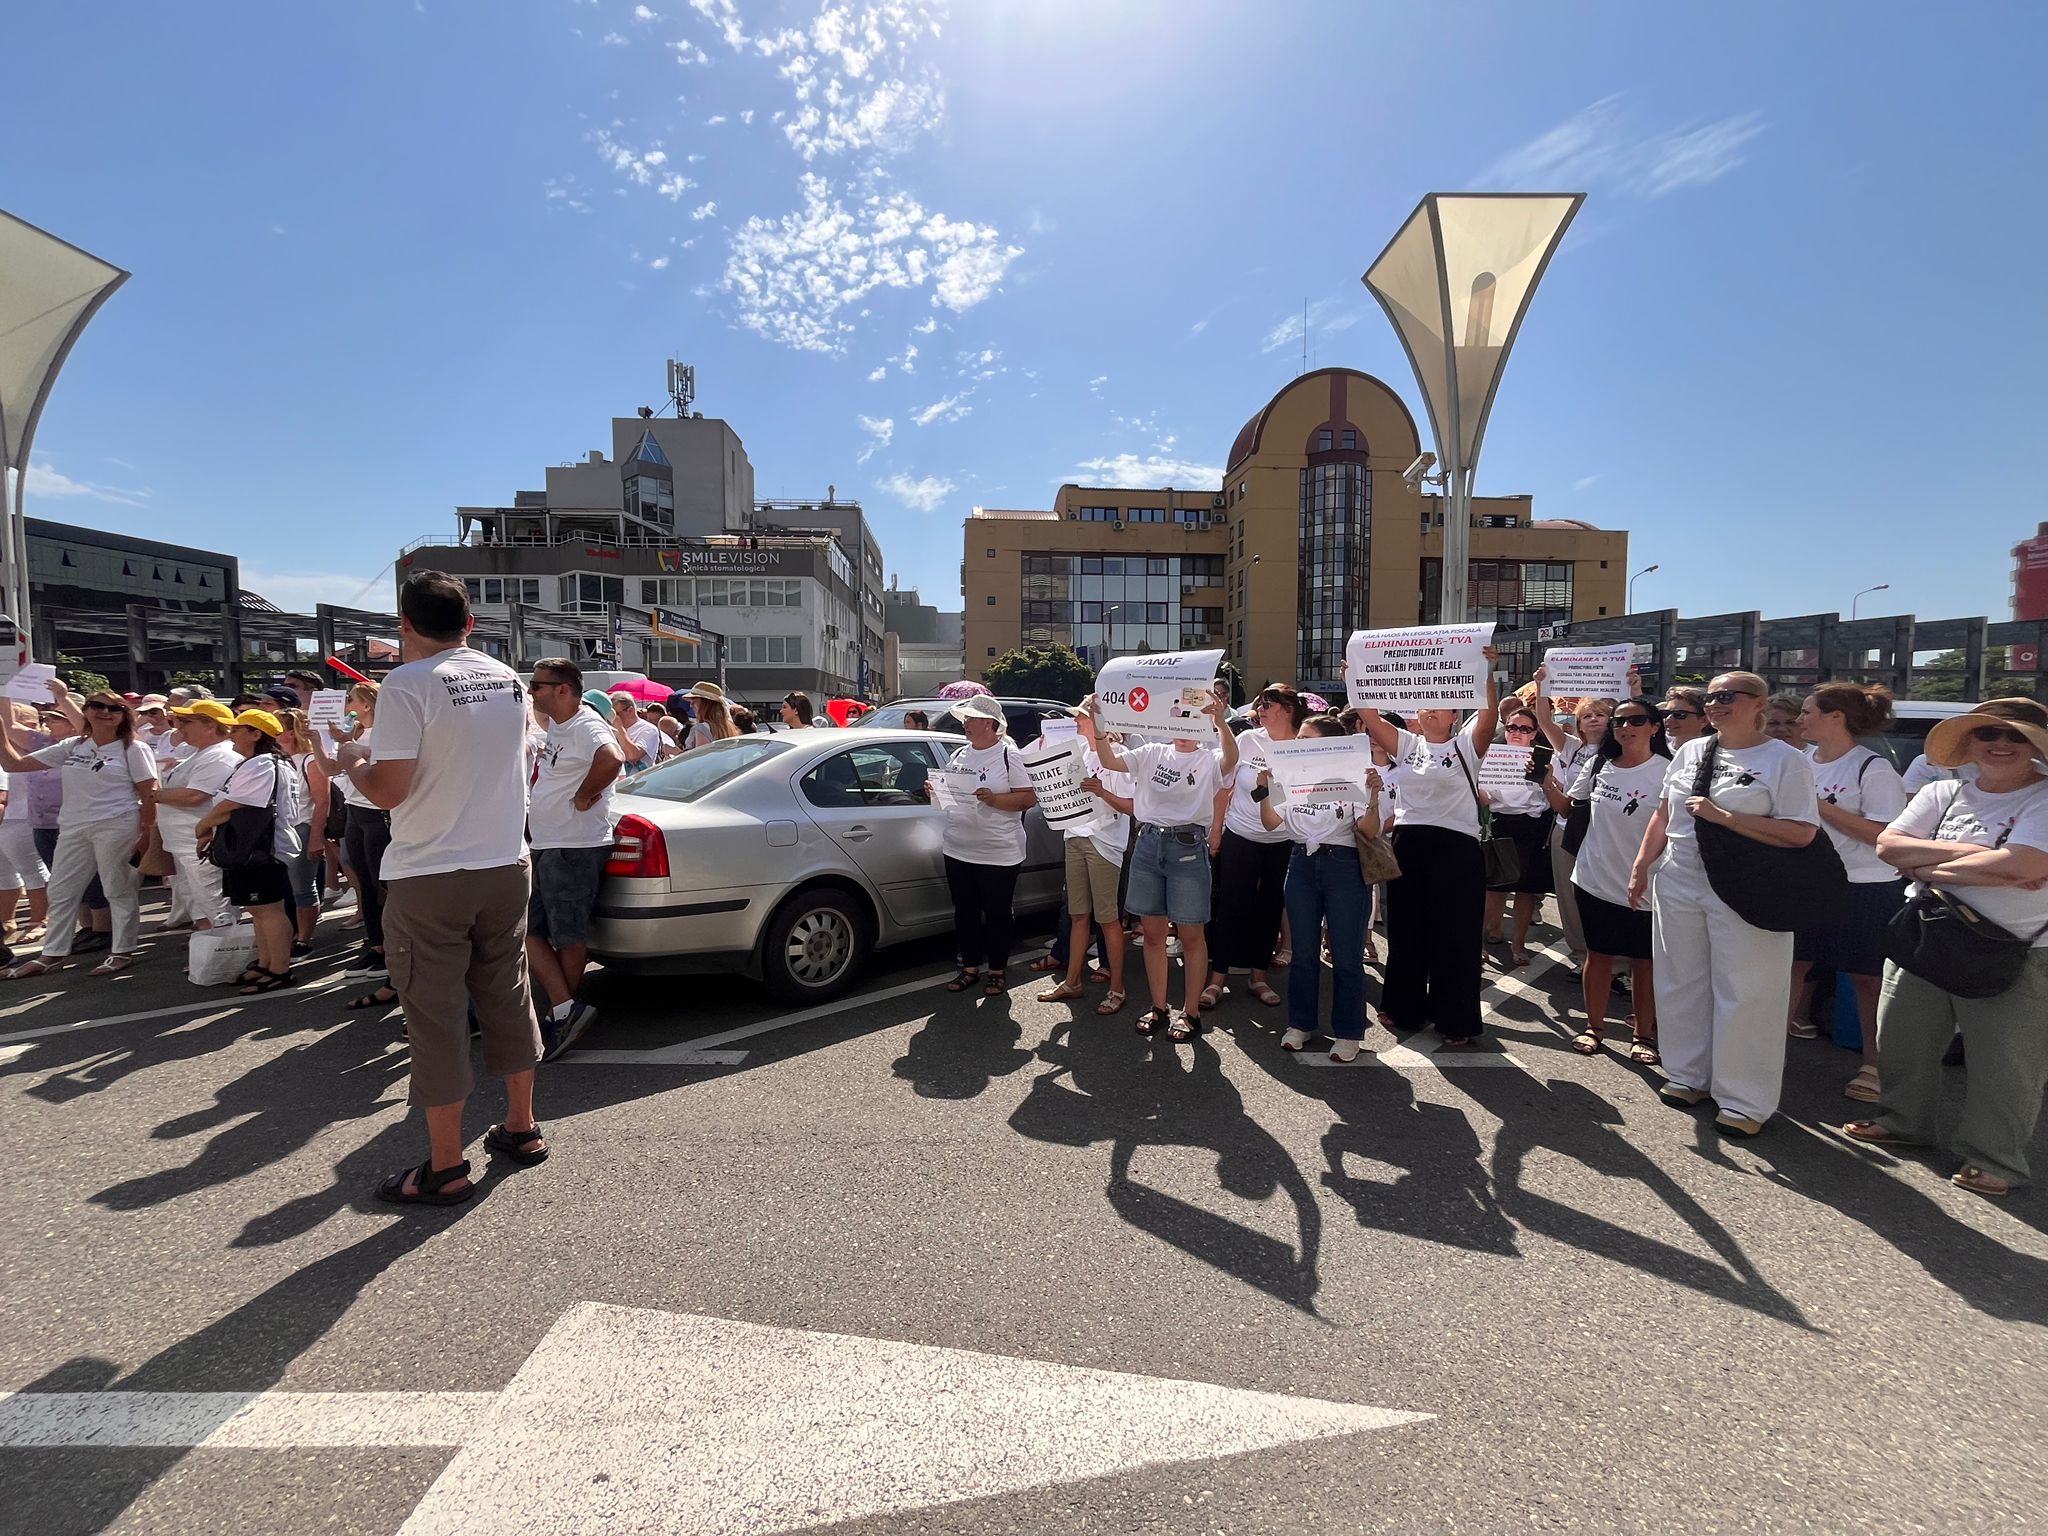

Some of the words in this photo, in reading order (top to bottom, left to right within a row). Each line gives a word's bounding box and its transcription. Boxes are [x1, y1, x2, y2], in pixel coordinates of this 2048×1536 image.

[682, 552, 780, 564] SMILEVISION
[710, 565, 766, 573] stomatologică
[1381, 631, 1401, 639] HAOS
[1450, 627, 1482, 635] FISCALĂ
[1364, 638, 1433, 649] ELIMINAREA
[1383, 648, 1445, 658] PREDICTIBILITATE
[1142, 657, 1184, 666] ANAF
[1365, 661, 1406, 673] CONSULTĂRI
[1408, 661, 1437, 672] PUBLICE
[1439, 660, 1462, 670] REALE
[1356, 676, 1412, 687] REINTRODUCEREA
[1414, 676, 1431, 685] LEGII
[1433, 675, 1474, 687] PREVENȚIEI
[446, 685, 460, 696] ÎN
[460, 681, 505, 693] LEGISLAȚIA
[452, 692, 488, 707] FISCALĂ
[1101, 691, 1126, 705] 404
[1357, 691, 1387, 700] TERMENE
[1389, 691, 1398, 700] DE
[1399, 691, 1439, 700] RAPORTARE
[1441, 690, 1474, 699] REALISTE
[1053, 778, 1074, 791] REALE
[1063, 796, 1094, 810] REALISTE
